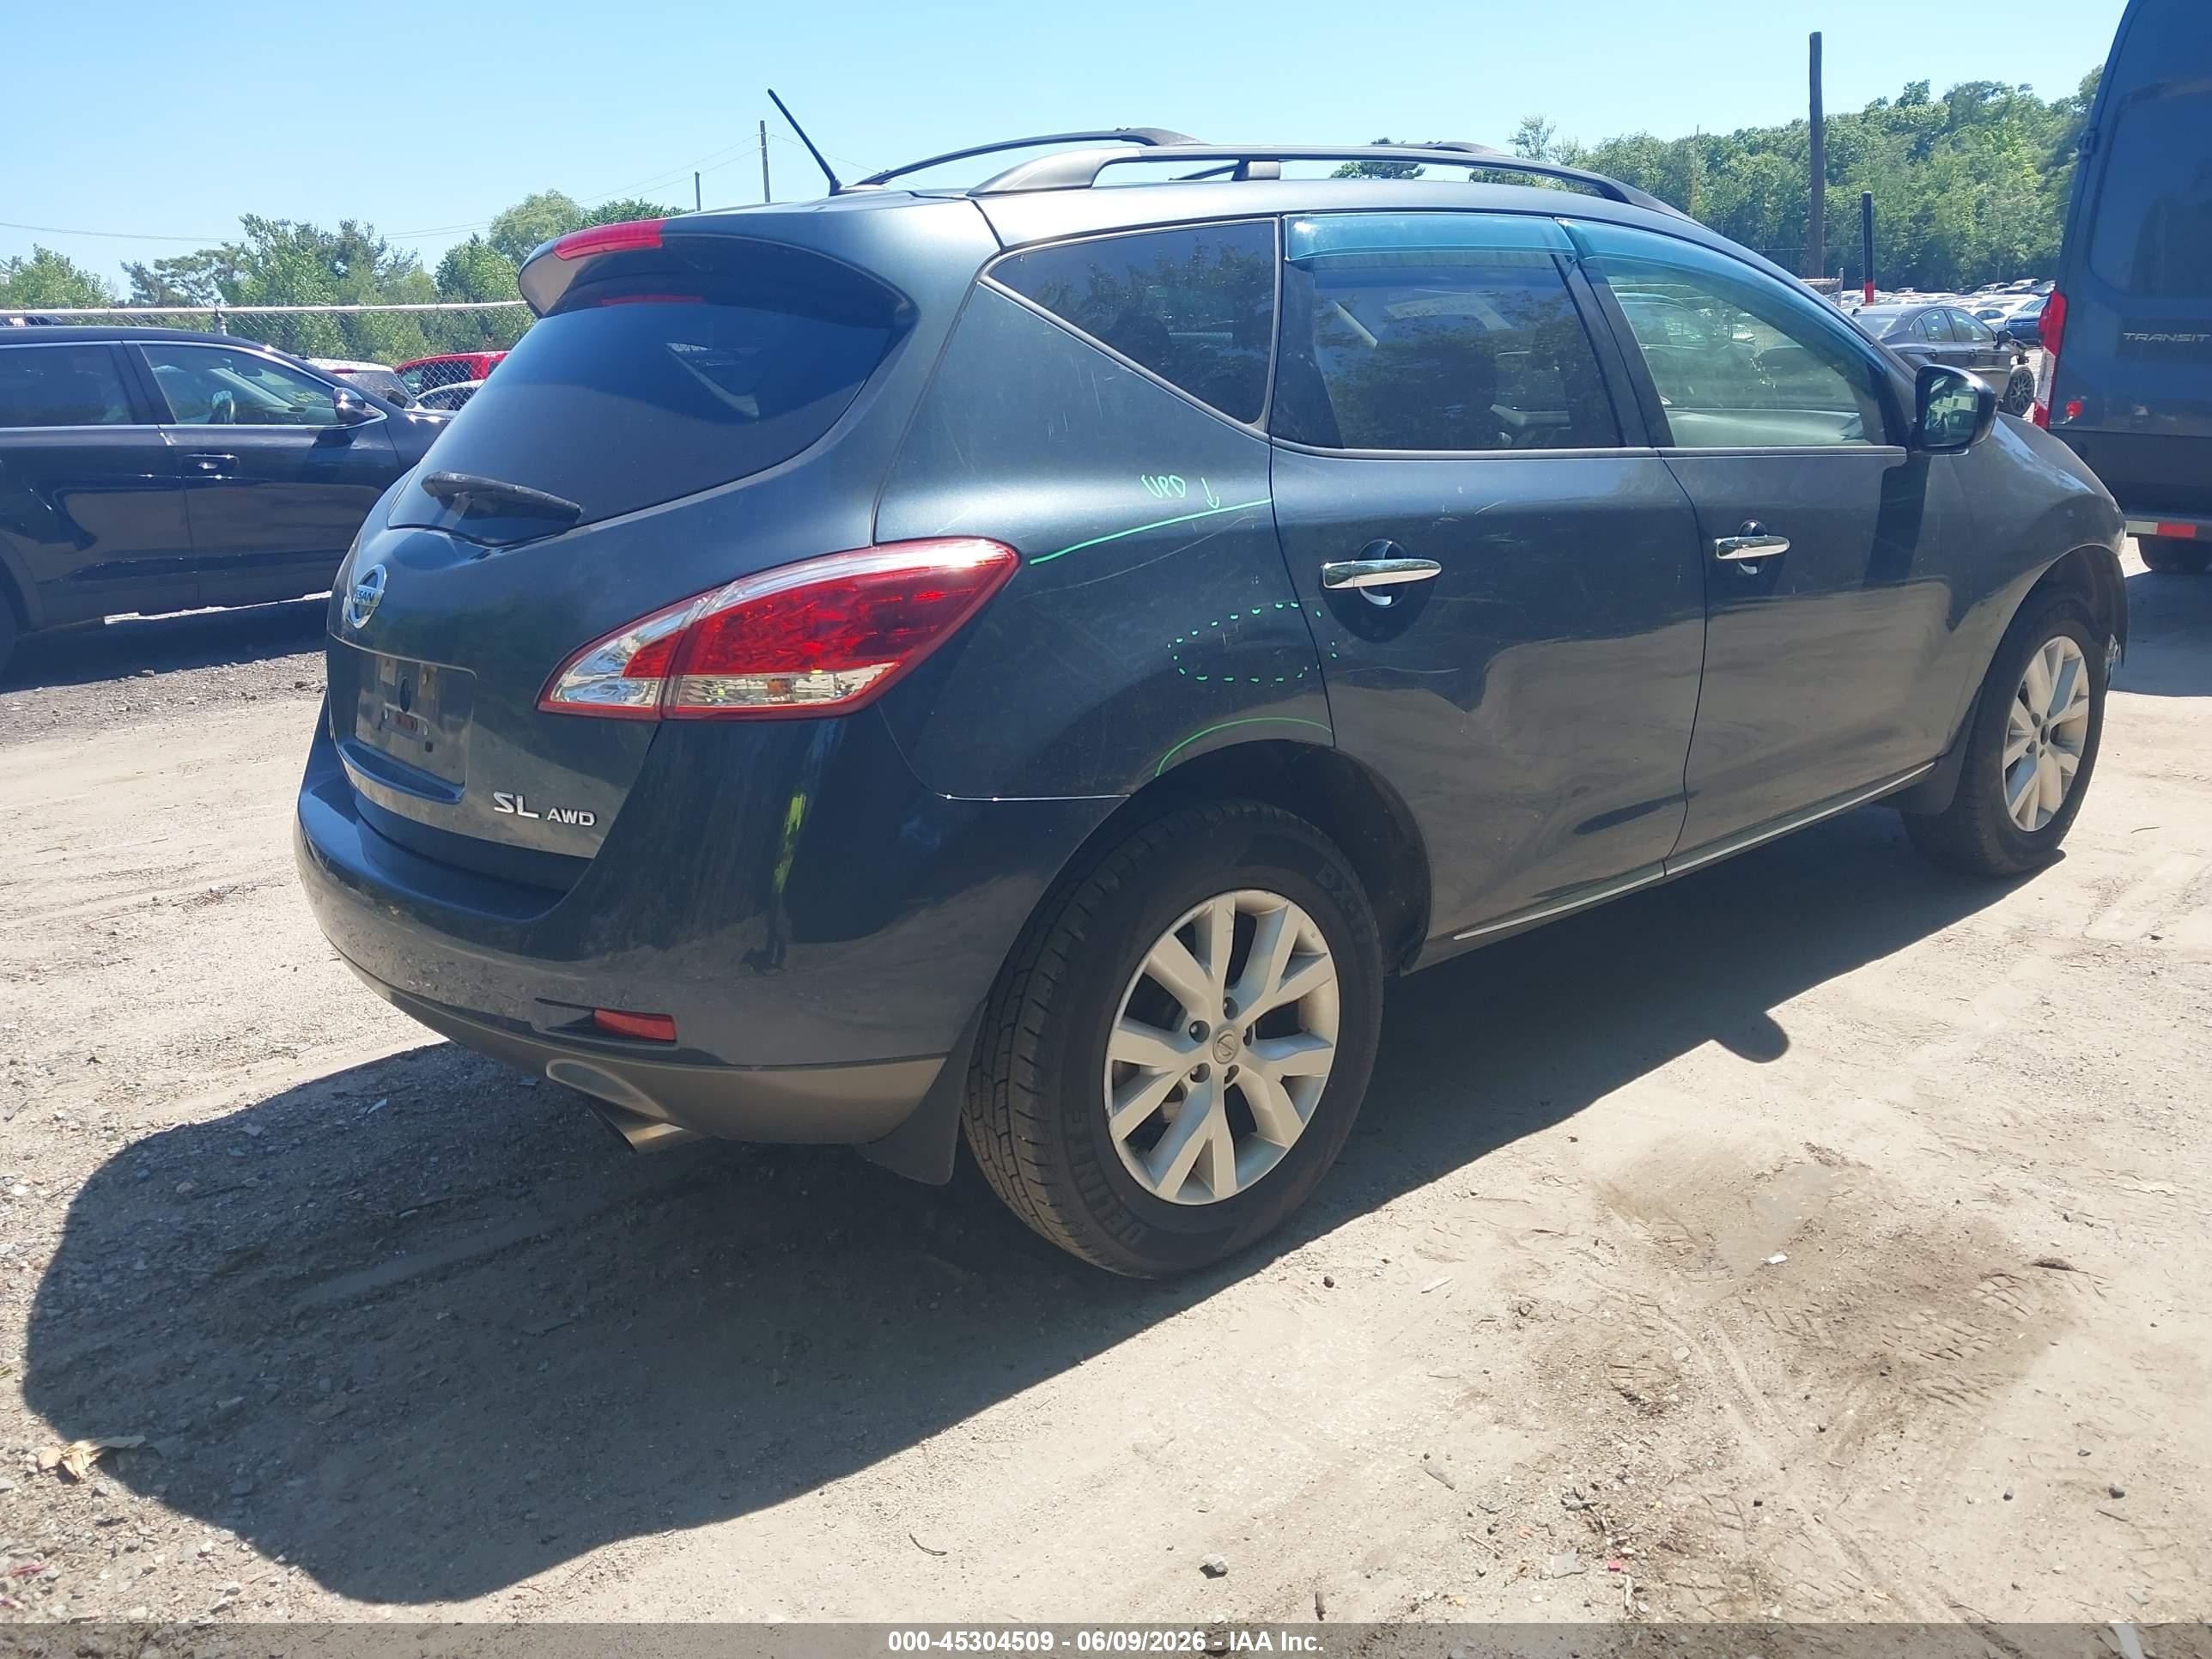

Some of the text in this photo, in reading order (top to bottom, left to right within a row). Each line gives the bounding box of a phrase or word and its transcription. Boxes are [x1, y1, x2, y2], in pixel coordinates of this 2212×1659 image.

[2122, 332, 2211, 343] TRANSIT
[493, 791, 596, 827] SL AWD
[1064, 1112, 1149, 1251] DELINTE
